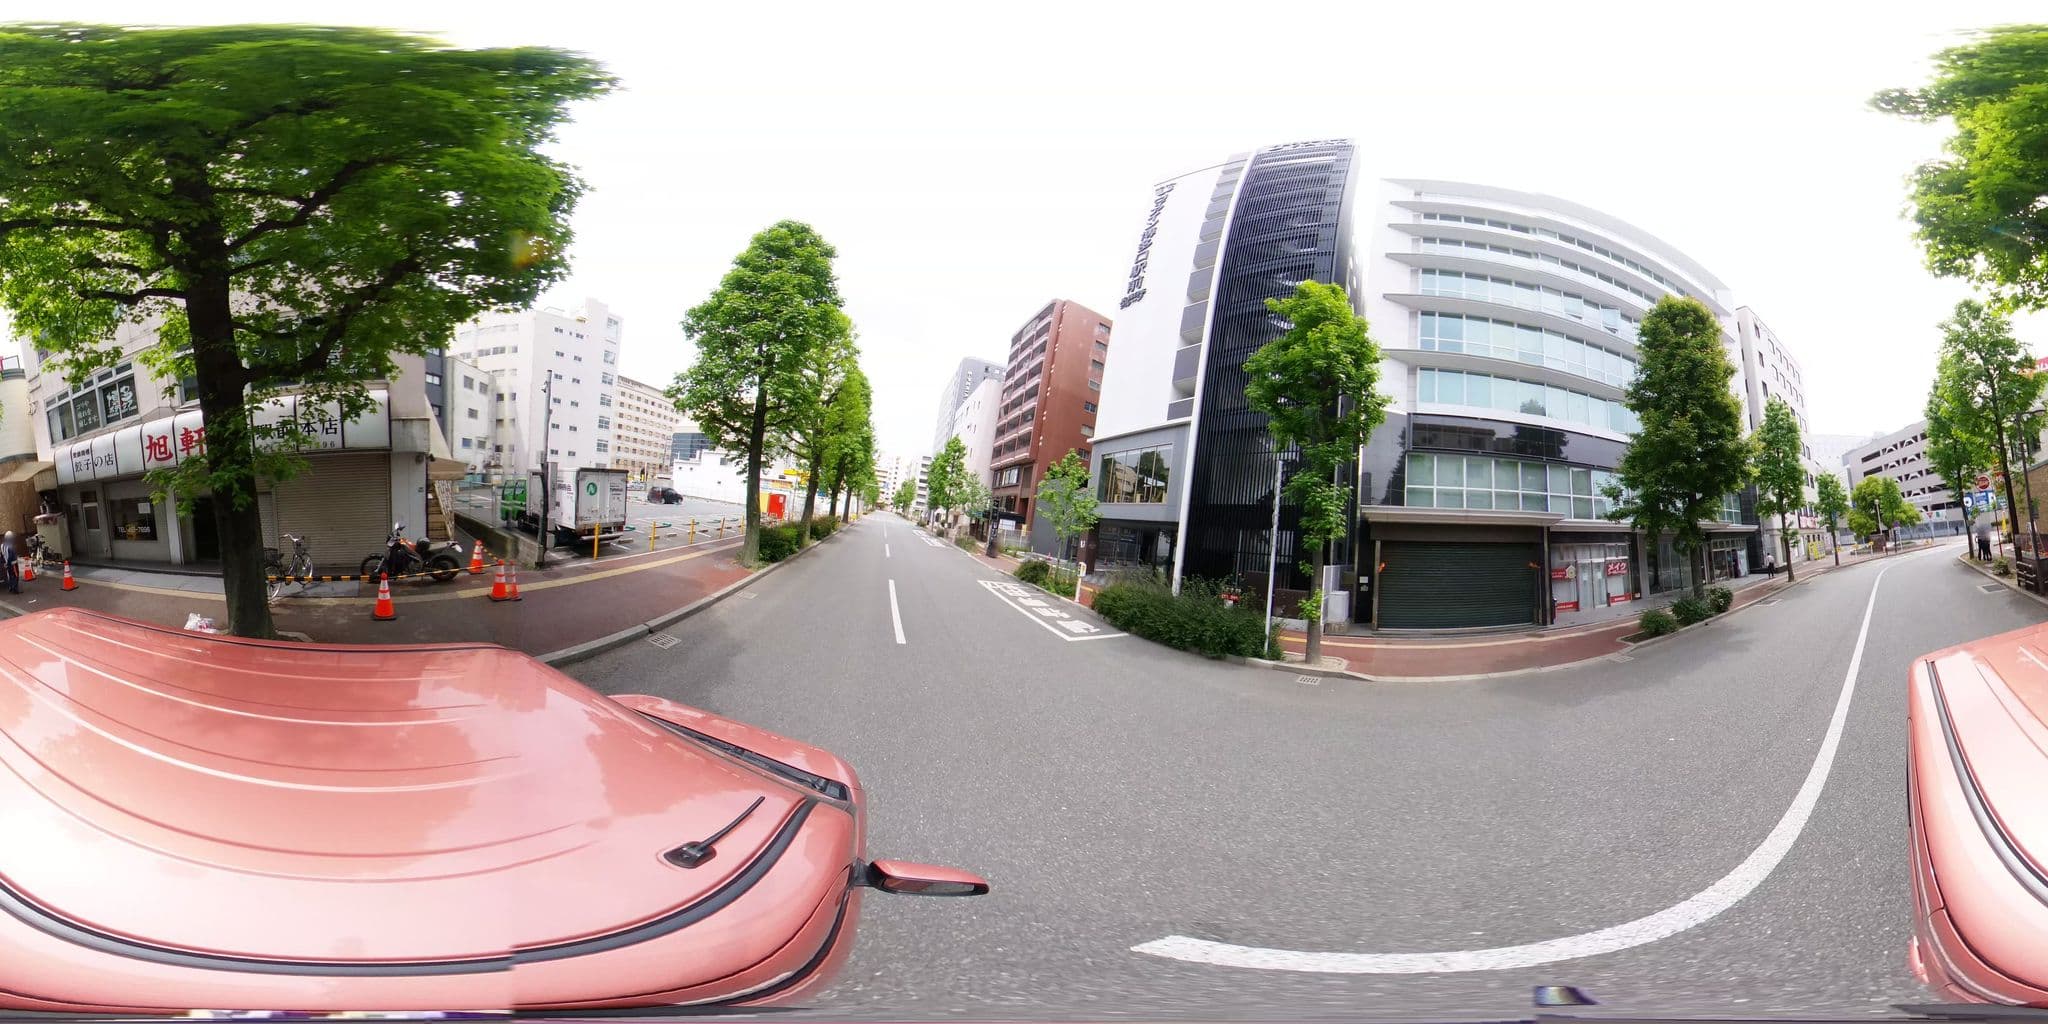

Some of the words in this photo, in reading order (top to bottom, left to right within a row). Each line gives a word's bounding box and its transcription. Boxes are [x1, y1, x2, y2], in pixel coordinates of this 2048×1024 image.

[146, 426, 208, 463] 旭軒
[75, 451, 114, 473] 餃子の店
[1608, 562, 1627, 571] メイク
